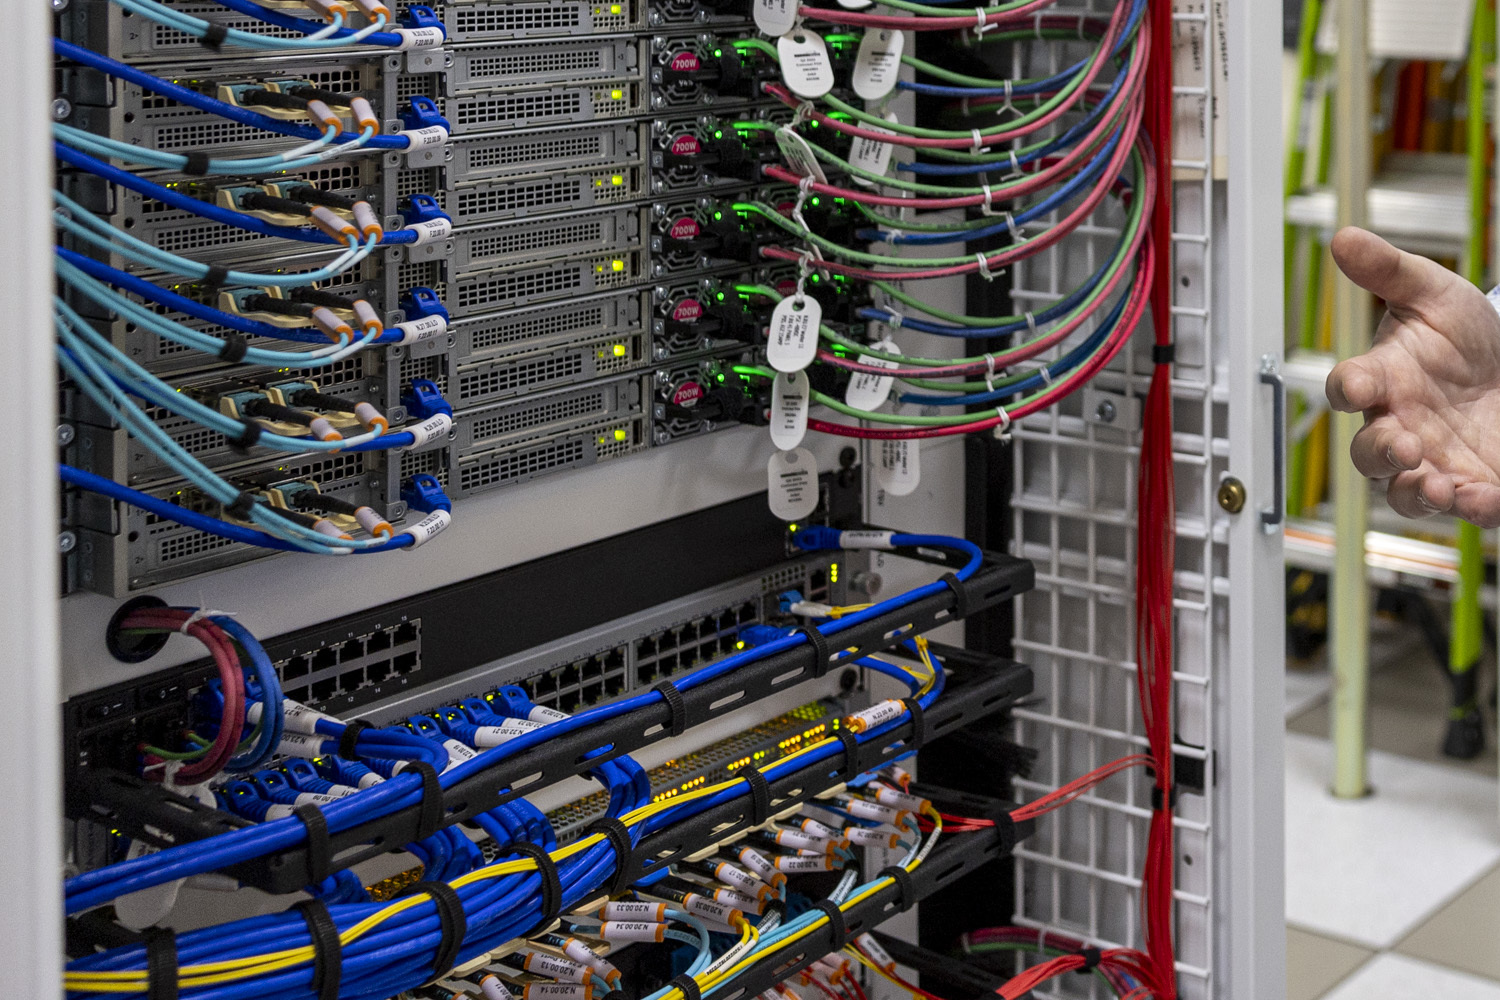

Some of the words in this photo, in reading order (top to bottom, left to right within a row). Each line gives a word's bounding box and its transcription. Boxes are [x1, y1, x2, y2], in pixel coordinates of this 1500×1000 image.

[675, 59, 696, 69] 700W
[675, 141, 696, 151] 700W
[674, 224, 695, 235] 700W
[677, 306, 699, 316] 700W
[677, 387, 699, 400] 700W
[492, 728, 525, 736] N.22.00.21
[540, 961, 575, 976] N.20.00.13
[540, 986, 576, 994] N.20.00.14
